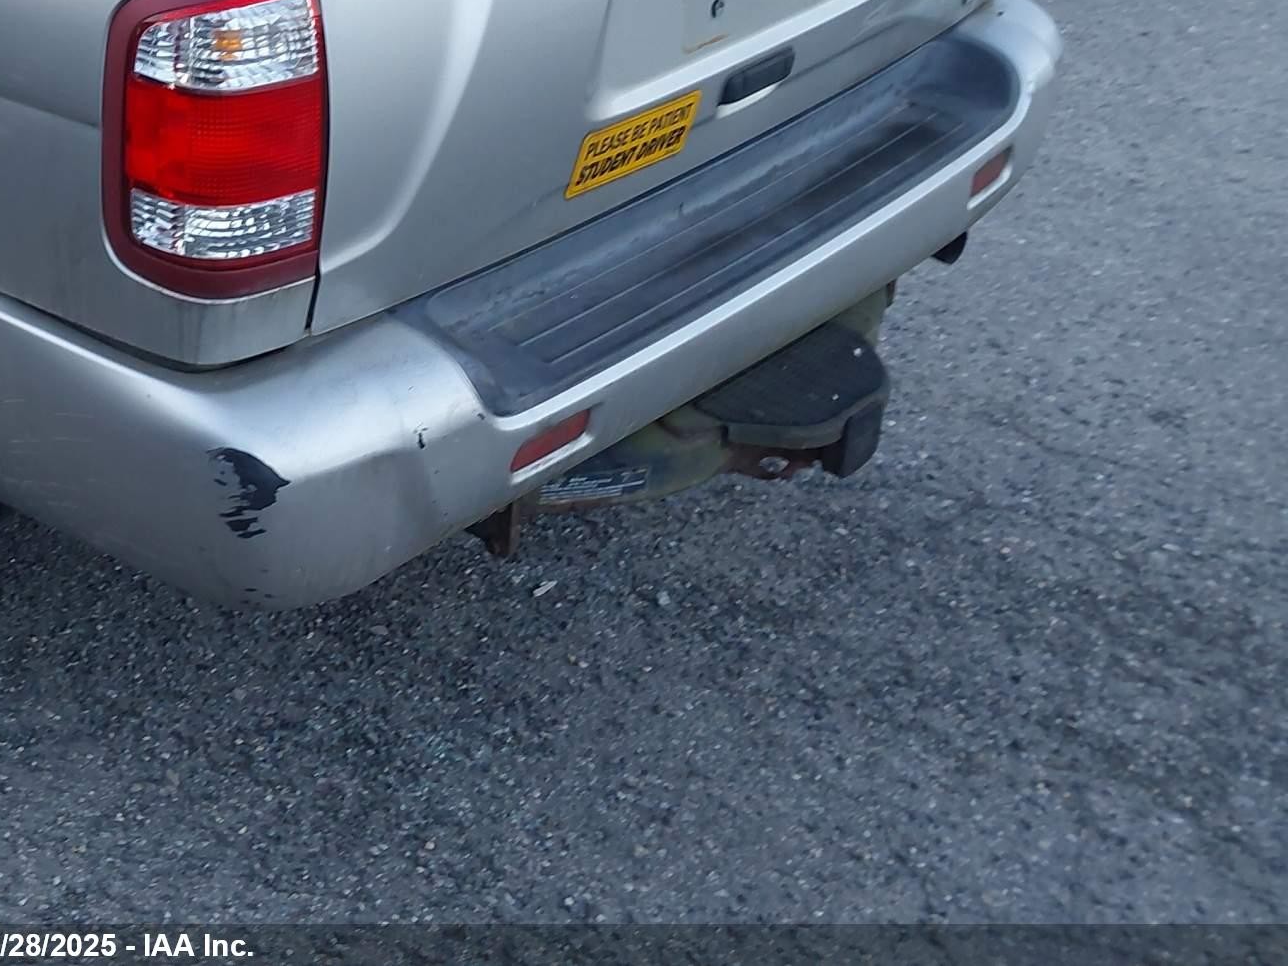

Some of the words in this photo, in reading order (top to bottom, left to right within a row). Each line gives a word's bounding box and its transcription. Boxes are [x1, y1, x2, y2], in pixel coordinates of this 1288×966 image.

[575, 146, 638, 186] STUDENT
[634, 126, 687, 161] DRIVER
[584, 128, 632, 161] PLEASE
[631, 121, 650, 141] BE
[648, 102, 695, 134] PATIENT
